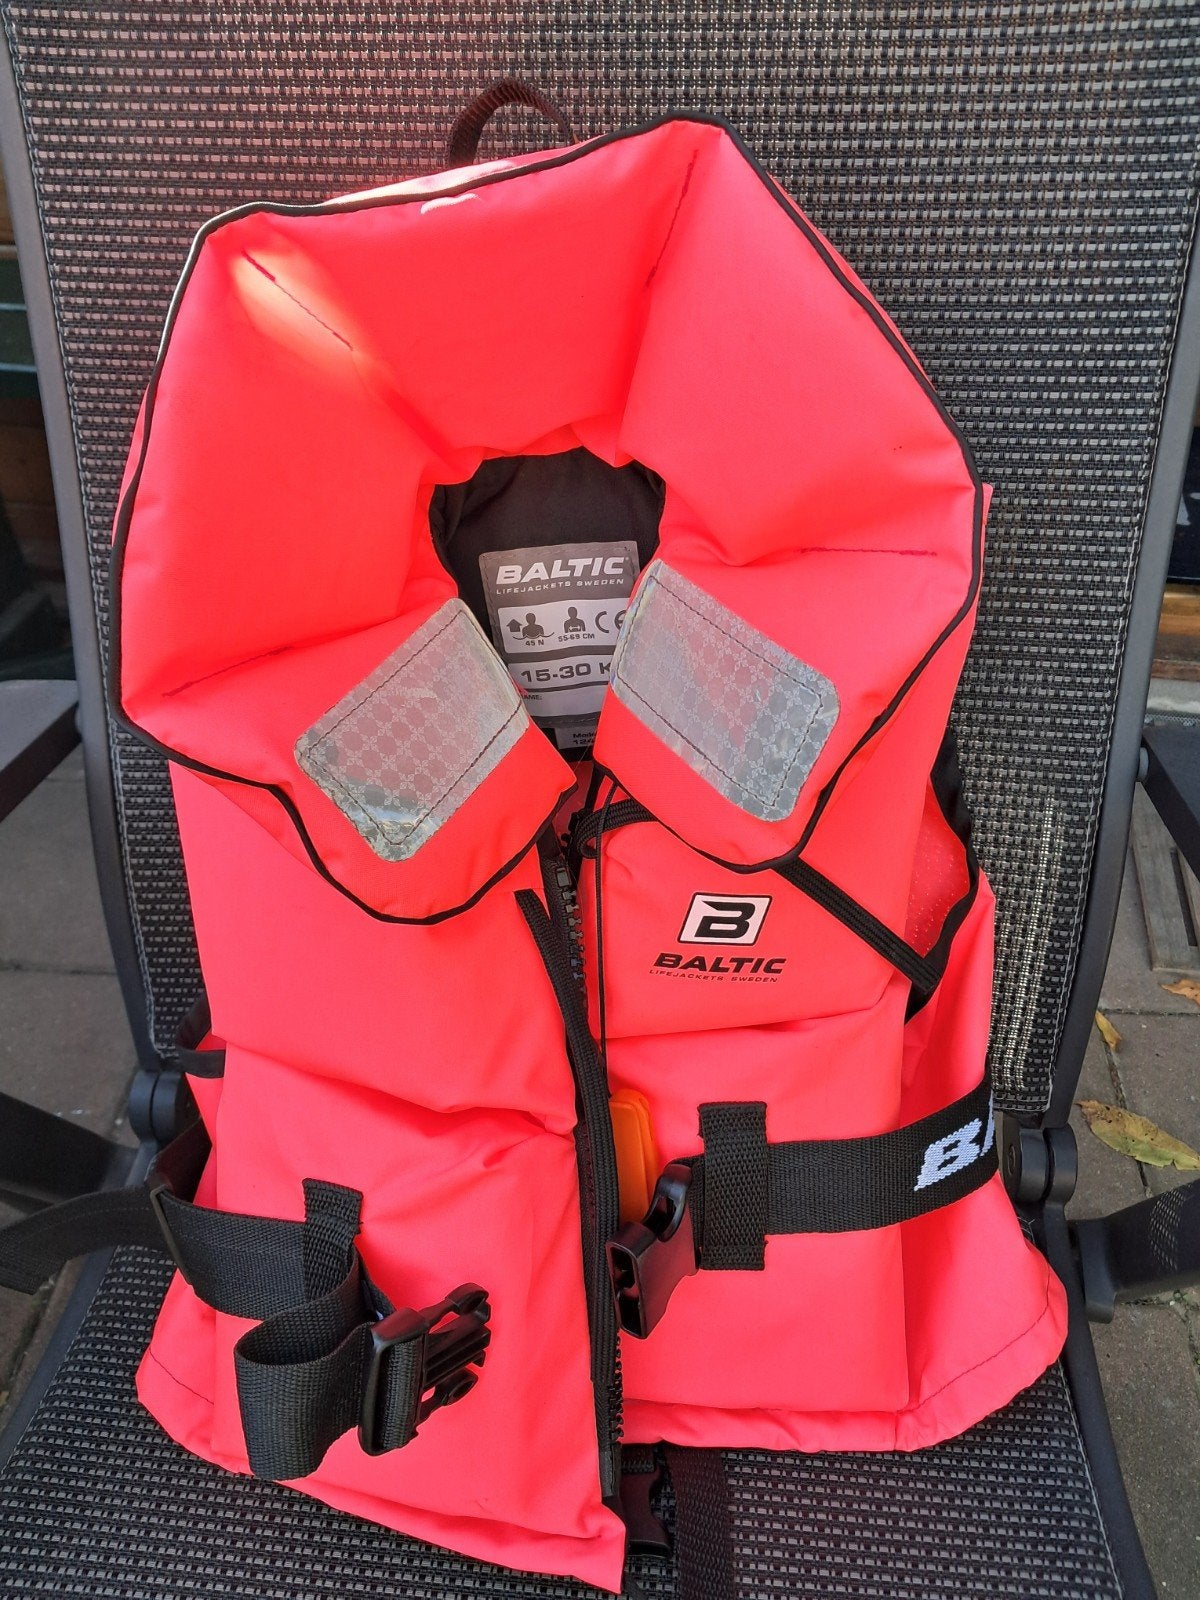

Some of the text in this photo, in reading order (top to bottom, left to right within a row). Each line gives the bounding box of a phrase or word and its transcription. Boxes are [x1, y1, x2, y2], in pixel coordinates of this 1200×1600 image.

[495, 556, 625, 585] BALTIC
[496, 578, 625, 595] LIFEJACKETS SWEDEN
[525, 638, 545, 647] 45 N
[557, 634, 581, 643] 55-69
[521, 662, 592, 683] 15-30
[653, 952, 788, 975] BALTIC
[649, 969, 724, 981] LIFEJACKETS
